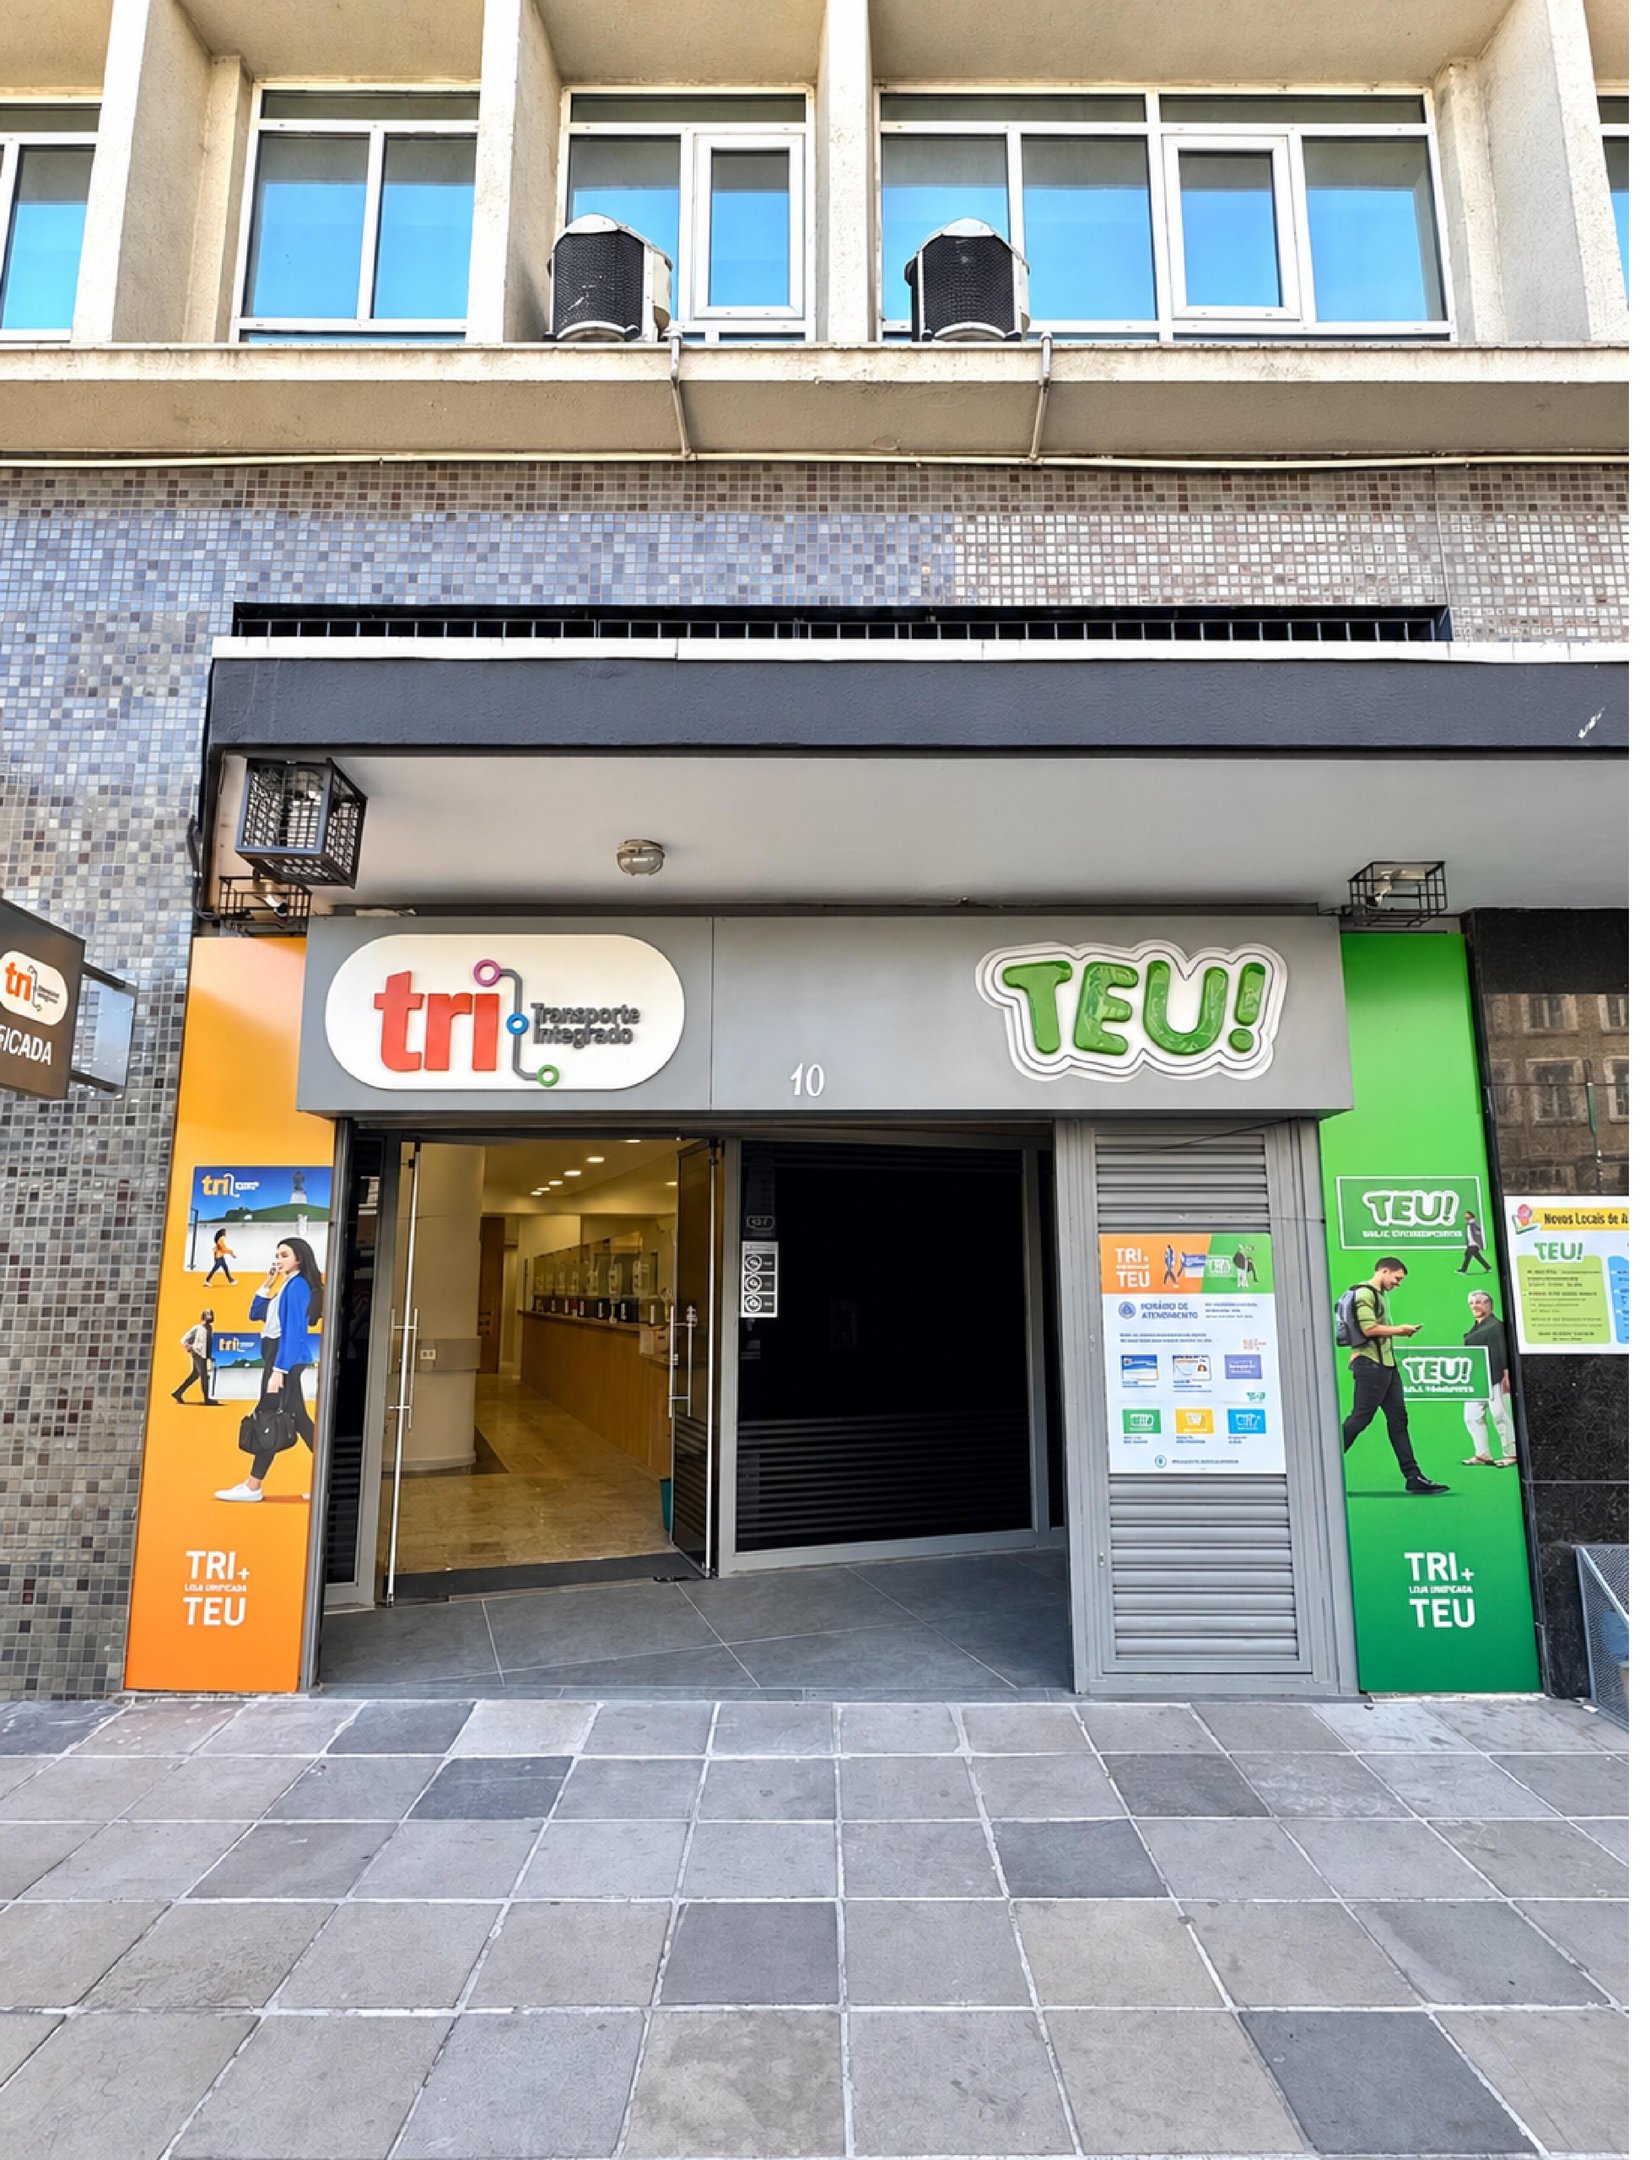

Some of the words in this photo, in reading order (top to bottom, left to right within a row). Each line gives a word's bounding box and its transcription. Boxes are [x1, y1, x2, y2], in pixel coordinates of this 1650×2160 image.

[374, 968, 500, 1072] tri
[530, 1003, 641, 1025] Transporte
[1002, 960, 1267, 1055] TEU!
[533, 1024, 634, 1049] Integrado
[789, 1063, 826, 1097] 10
[1367, 1195, 1455, 1222] TEU!
[1544, 1213, 1574, 1224] Novos
[1575, 1212, 1605, 1224] Locais
[1534, 1242, 1584, 1261] TEU!
[1116, 1271, 1151, 1288] TEU
[1405, 1360, 1469, 1381] TEU!
[183, 1597, 246, 1627] TEU
[1409, 1598, 1476, 1629] TEU
